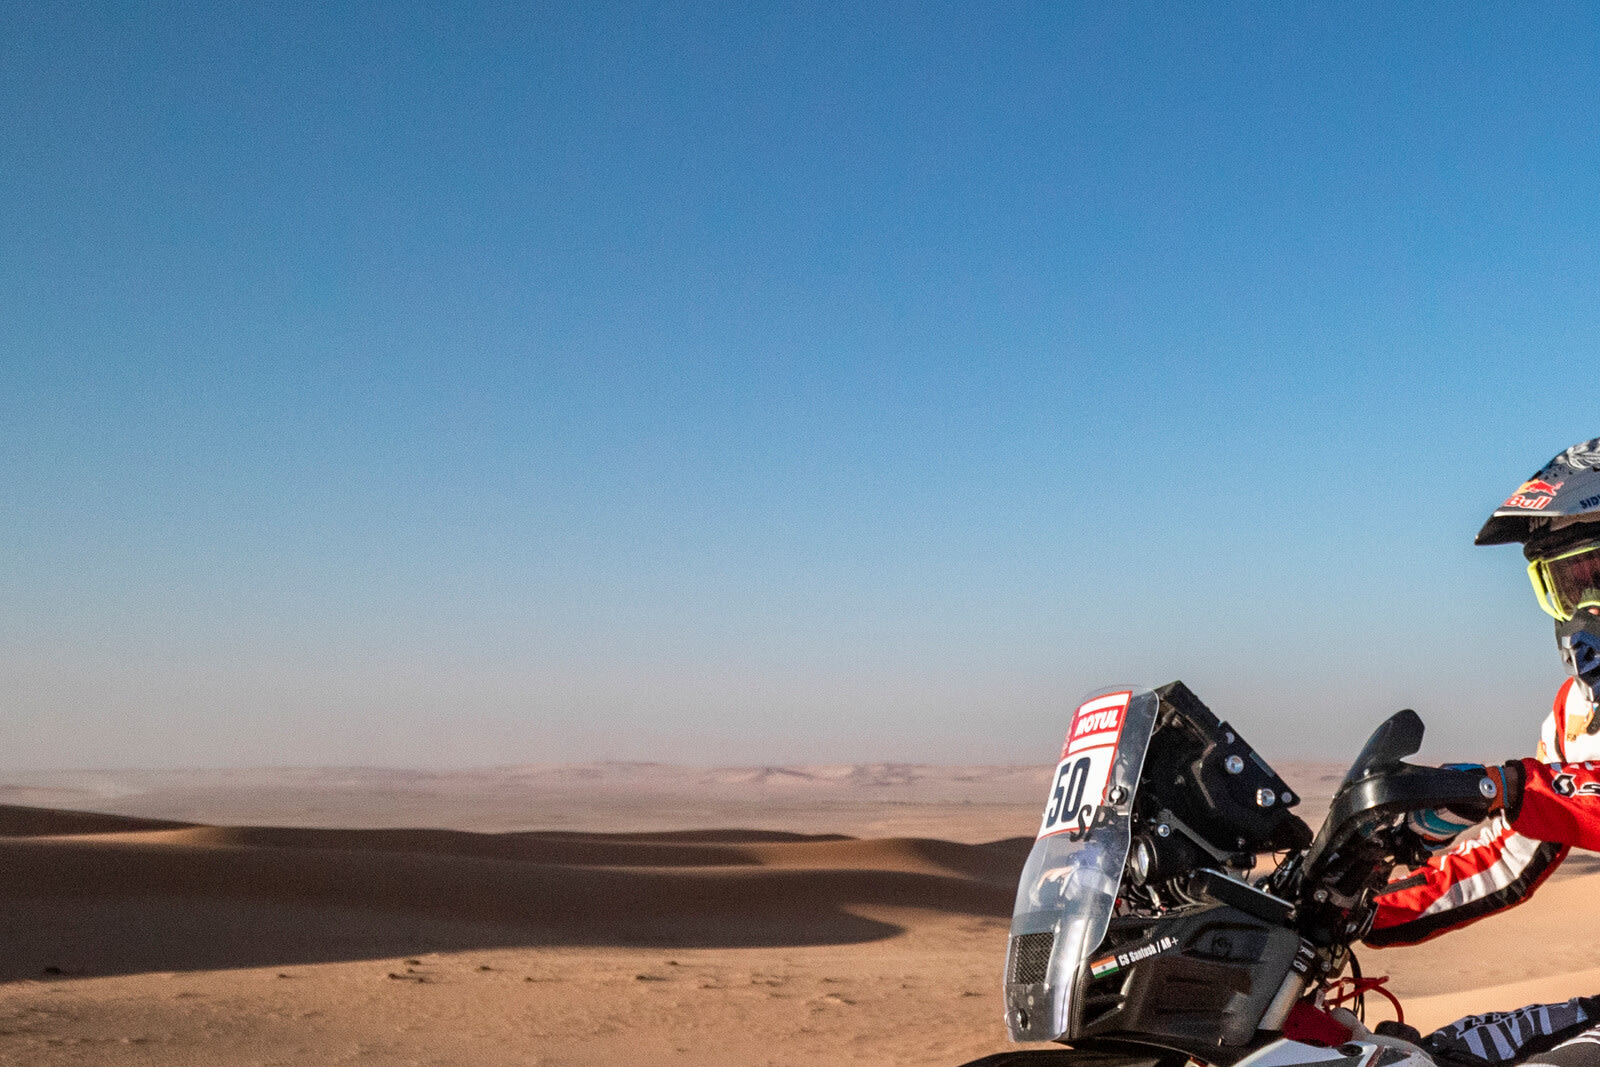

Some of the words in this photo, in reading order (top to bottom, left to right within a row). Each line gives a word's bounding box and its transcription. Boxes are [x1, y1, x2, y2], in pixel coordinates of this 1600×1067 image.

[1504, 495, 1553, 510] Bull
[1074, 709, 1119, 737] MOTUL
[1046, 757, 1091, 829] 50
